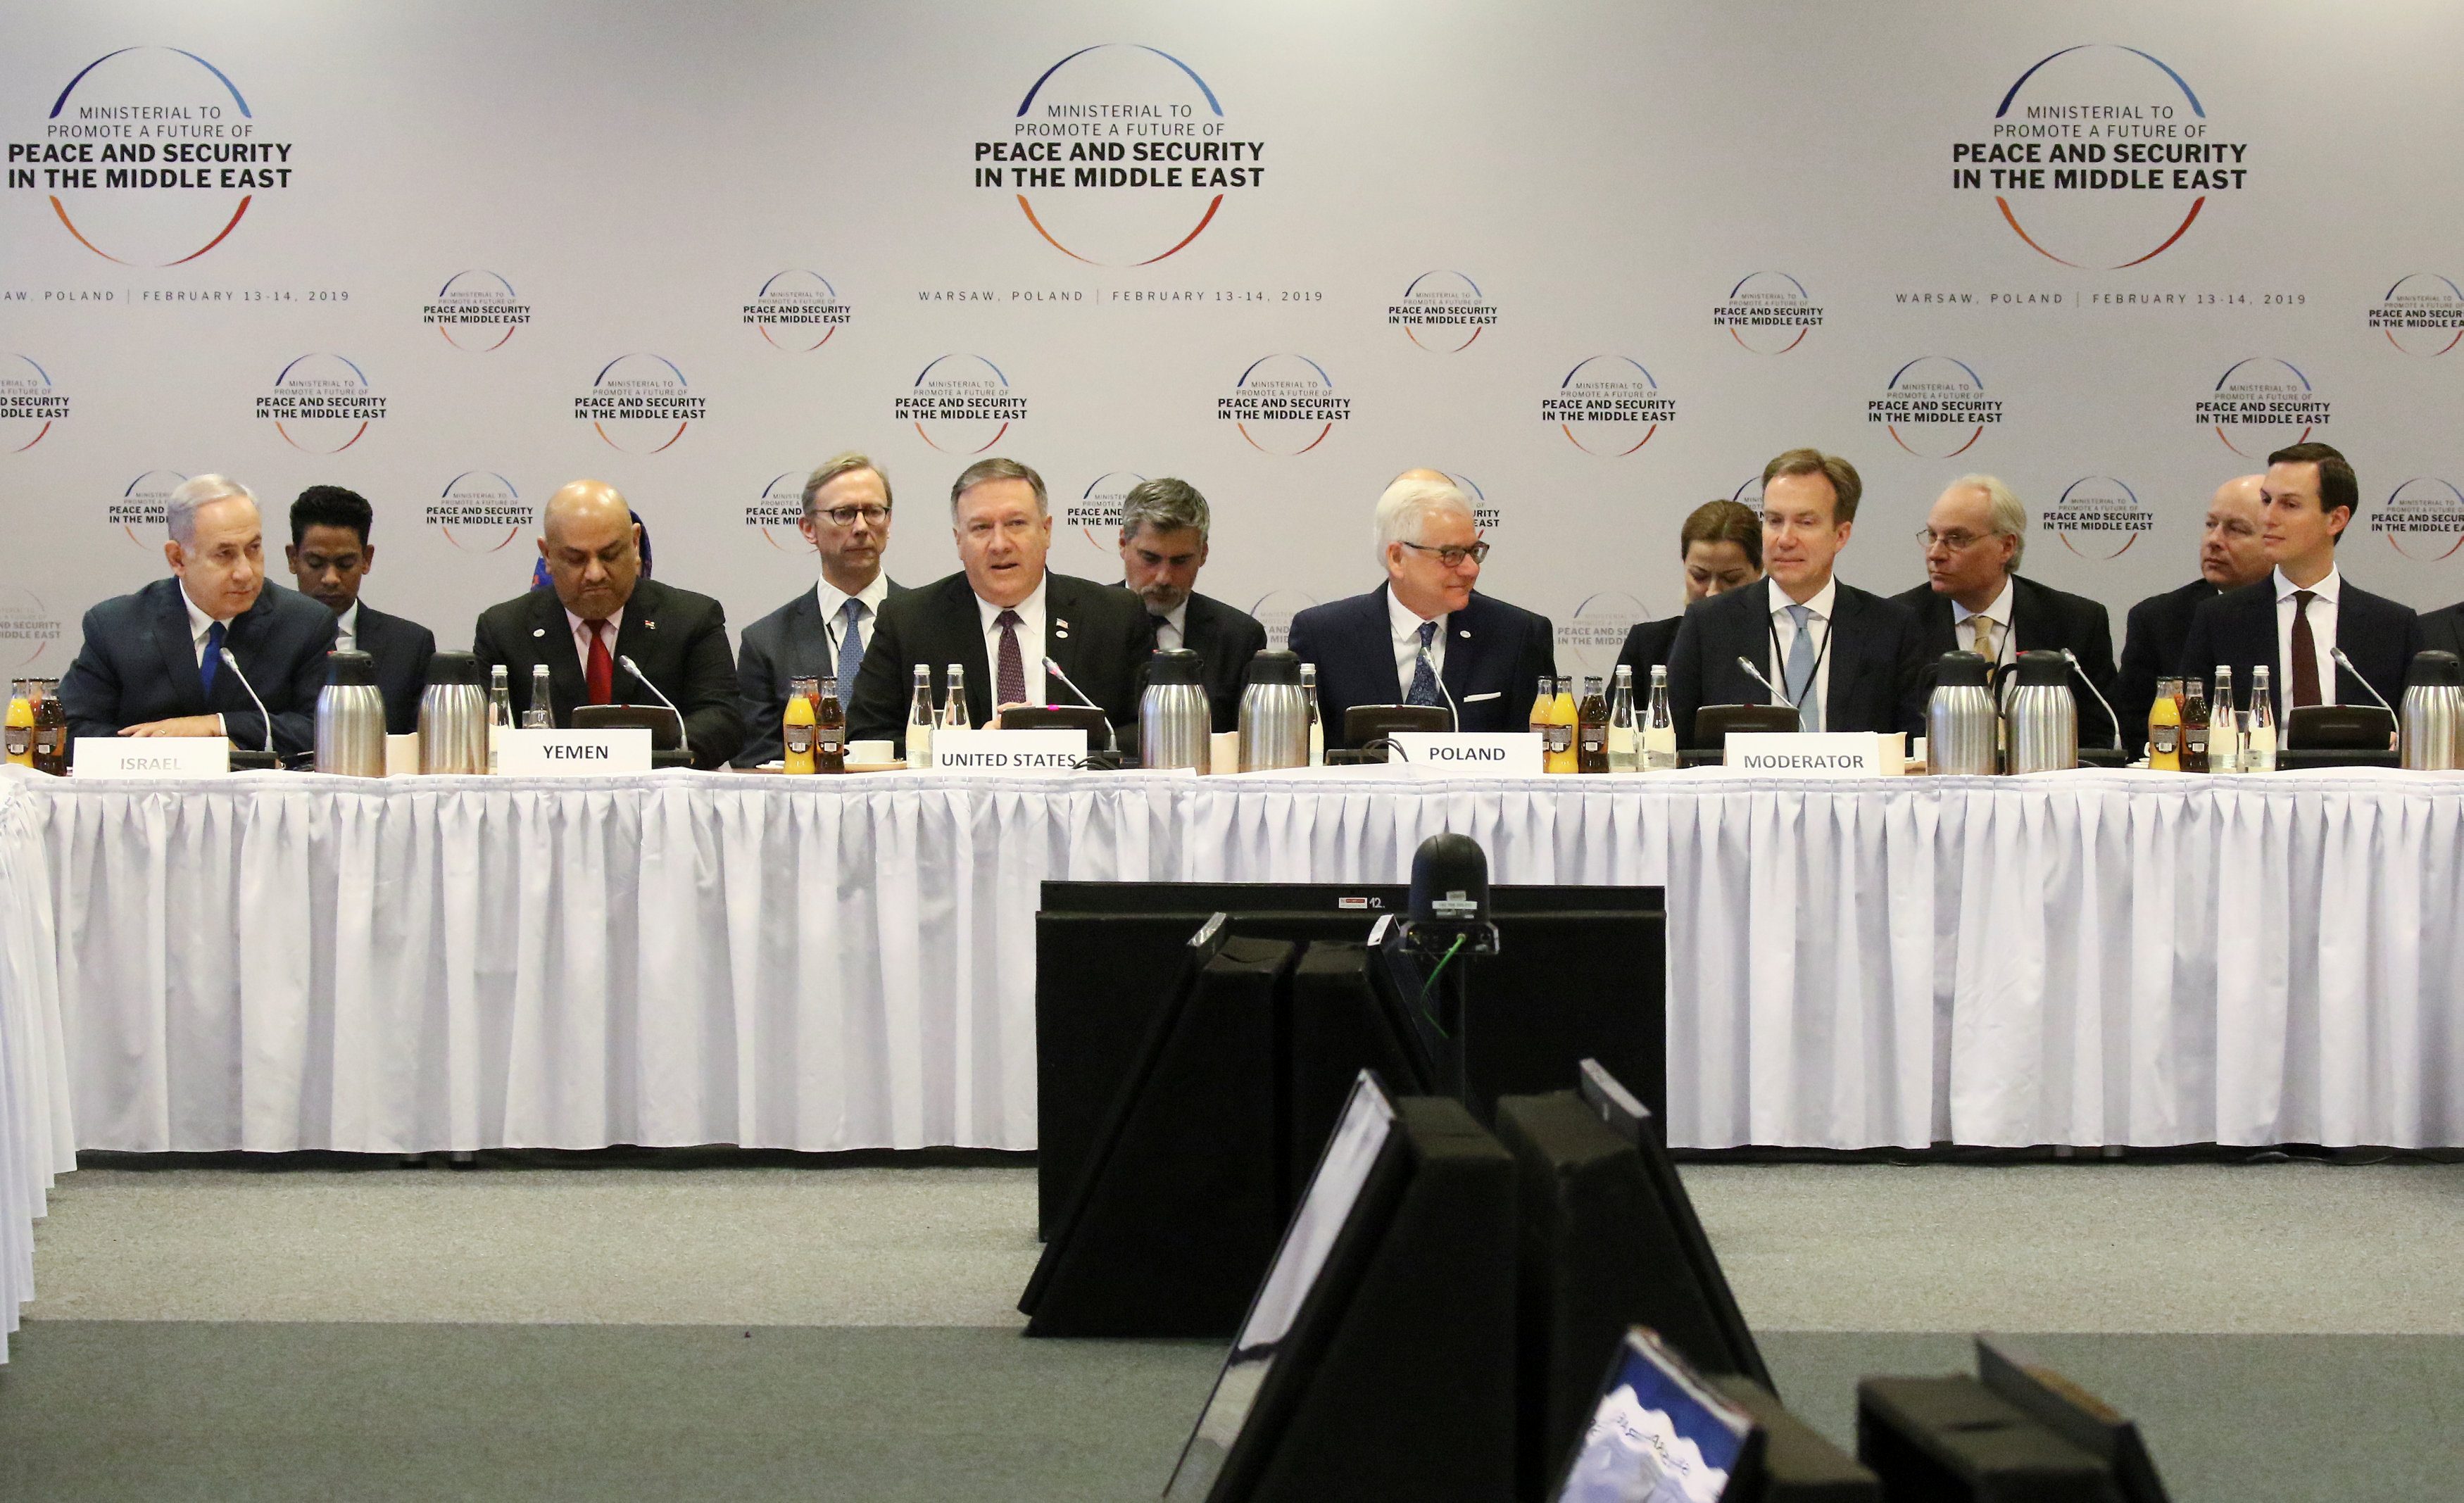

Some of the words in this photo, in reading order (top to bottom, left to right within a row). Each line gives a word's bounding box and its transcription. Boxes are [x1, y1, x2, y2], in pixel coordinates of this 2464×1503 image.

[80, 107, 191, 119] MINISTERIAL
[200, 106, 222, 119] TO
[1048, 105, 1162, 117] MINISTERIAL
[1170, 105, 1191, 117] TO
[2028, 106, 2143, 119] MINISTERIAL
[2151, 106, 2173, 119] TO
[48, 125, 132, 137] PROMOTE
[139, 125, 149, 137] A
[158, 125, 224, 137] FUTURE
[232, 125, 253, 137] OF
[1015, 123, 1101, 136] PROMOTE
[1109, 124, 1119, 135] A
[1127, 123, 1195, 136] FUTURE
[1203, 123, 1224, 135] OF
[1994, 125, 2081, 137] PROMOTE
[2089, 125, 2099, 137] A
[2108, 125, 2176, 137] FUTURE
[2185, 125, 2207, 137] OF
[8, 144, 93, 163] PEACE
[101, 144, 155, 163] AND
[163, 144, 292, 163] SECURITY
[976, 142, 1061, 161] PEACE
[1069, 142, 1124, 161] AND
[1133, 142, 1264, 161] SECURITY
[1954, 144, 2040, 163] PEACE
[2049, 144, 2106, 163] AND
[2114, 144, 2246, 163] SECURITY
[8, 169, 35, 188] IN
[44, 169, 97, 188] THE
[106, 169, 211, 188] MIDDLE
[221, 169, 292, 188] EAST
[976, 168, 1002, 187] IN
[1012, 168, 1065, 187] THE
[1075, 168, 1182, 187] MIDDLE
[1192, 168, 1264, 187] EAST
[1954, 170, 1980, 189] IN
[1990, 170, 2044, 189] THE
[2055, 170, 2163, 189] MIDDLE
[2174, 170, 2246, 189] EAST
[45, 291, 114, 301] POLAND
[144, 291, 233, 301] FEBRUARY
[244, 291, 298, 302] 13-14,
[309, 291, 349, 301] 2019
[919, 291, 1001, 302] WARSAW,
[1012, 291, 1083, 301] POLAND
[1113, 291, 1205, 301] FEBRUARY
[1217, 291, 1270, 302] 13-14,
[1282, 291, 1323, 301] 2019
[1896, 294, 1980, 304] WARSAW,
[1991, 294, 2063, 303] POLAND
[2093, 294, 2187, 304] FEBRUARY
[2198, 294, 2253, 305] 13-14,
[2265, 294, 2306, 304] 2019
[256, 398, 295, 407] PEACE
[298, 398, 323, 407] AND
[327, 398, 386, 407] SECURITY
[574, 398, 613, 407] PEACE
[617, 398, 642, 407] AND
[646, 398, 705, 407] SECURITY
[895, 398, 935, 408] PEACE
[938, 398, 964, 408] AND
[967, 398, 1027, 408] SECURITY
[1218, 398, 1257, 408] PEACE
[1261, 398, 1286, 408] AND
[1290, 398, 1350, 408] SECURITY
[1543, 400, 1582, 409] PEACE
[1586, 400, 1611, 409] AND
[1615, 400, 1676, 409] SECURITY
[1868, 401, 1908, 410] PEACE
[1912, 401, 1937, 410] AND
[1941, 401, 2001, 410] SECURITY
[2196, 403, 2236, 412] PEACE
[2239, 403, 2265, 412] AND
[2269, 403, 2330, 412] SECURITY
[256, 409, 268, 419] IN
[272, 409, 296, 419] THE
[301, 409, 349, 419] MIDDLE
[353, 409, 386, 419] EAST
[574, 409, 586, 419] IN
[591, 409, 615, 419] THE
[620, 409, 668, 419] MIDDLE
[673, 409, 705, 419] EAST
[895, 410, 907, 420] IN
[912, 410, 936, 420] THE
[941, 410, 990, 420] MIDDLE
[995, 410, 1028, 420] EAST
[1218, 410, 1230, 420] IN
[1235, 410, 1259, 420] THE
[1264, 410, 1312, 420] MIDDLE
[1317, 410, 1350, 420] EAST
[1543, 412, 1555, 422] IN
[1559, 412, 1584, 422] THE
[1588, 412, 1638, 422] MIDDLE
[1642, 412, 1676, 422] EAST
[1868, 413, 1881, 423] IN
[1885, 413, 1910, 423] THE
[1914, 413, 1964, 423] MIDDLE
[1968, 413, 2002, 423] EAST
[2196, 414, 2208, 424] IN
[2213, 414, 2237, 424] THE
[2242, 414, 2292, 424] MIDDLE
[2296, 414, 2330, 424] EAST
[2043, 522, 2053, 531] IN
[2057, 522, 2078, 531] THE
[2081, 522, 2121, 531] MIDDLE
[2125, 522, 2153, 531] EAST
[543, 746, 608, 759] YEMEN
[1431, 748, 1505, 760] POLAND
[120, 758, 182, 770] ISRAEL
[941, 753, 1007, 767] UNITED
[1013, 753, 1077, 767] STATES
[1744, 755, 1864, 768] MODERATOR
